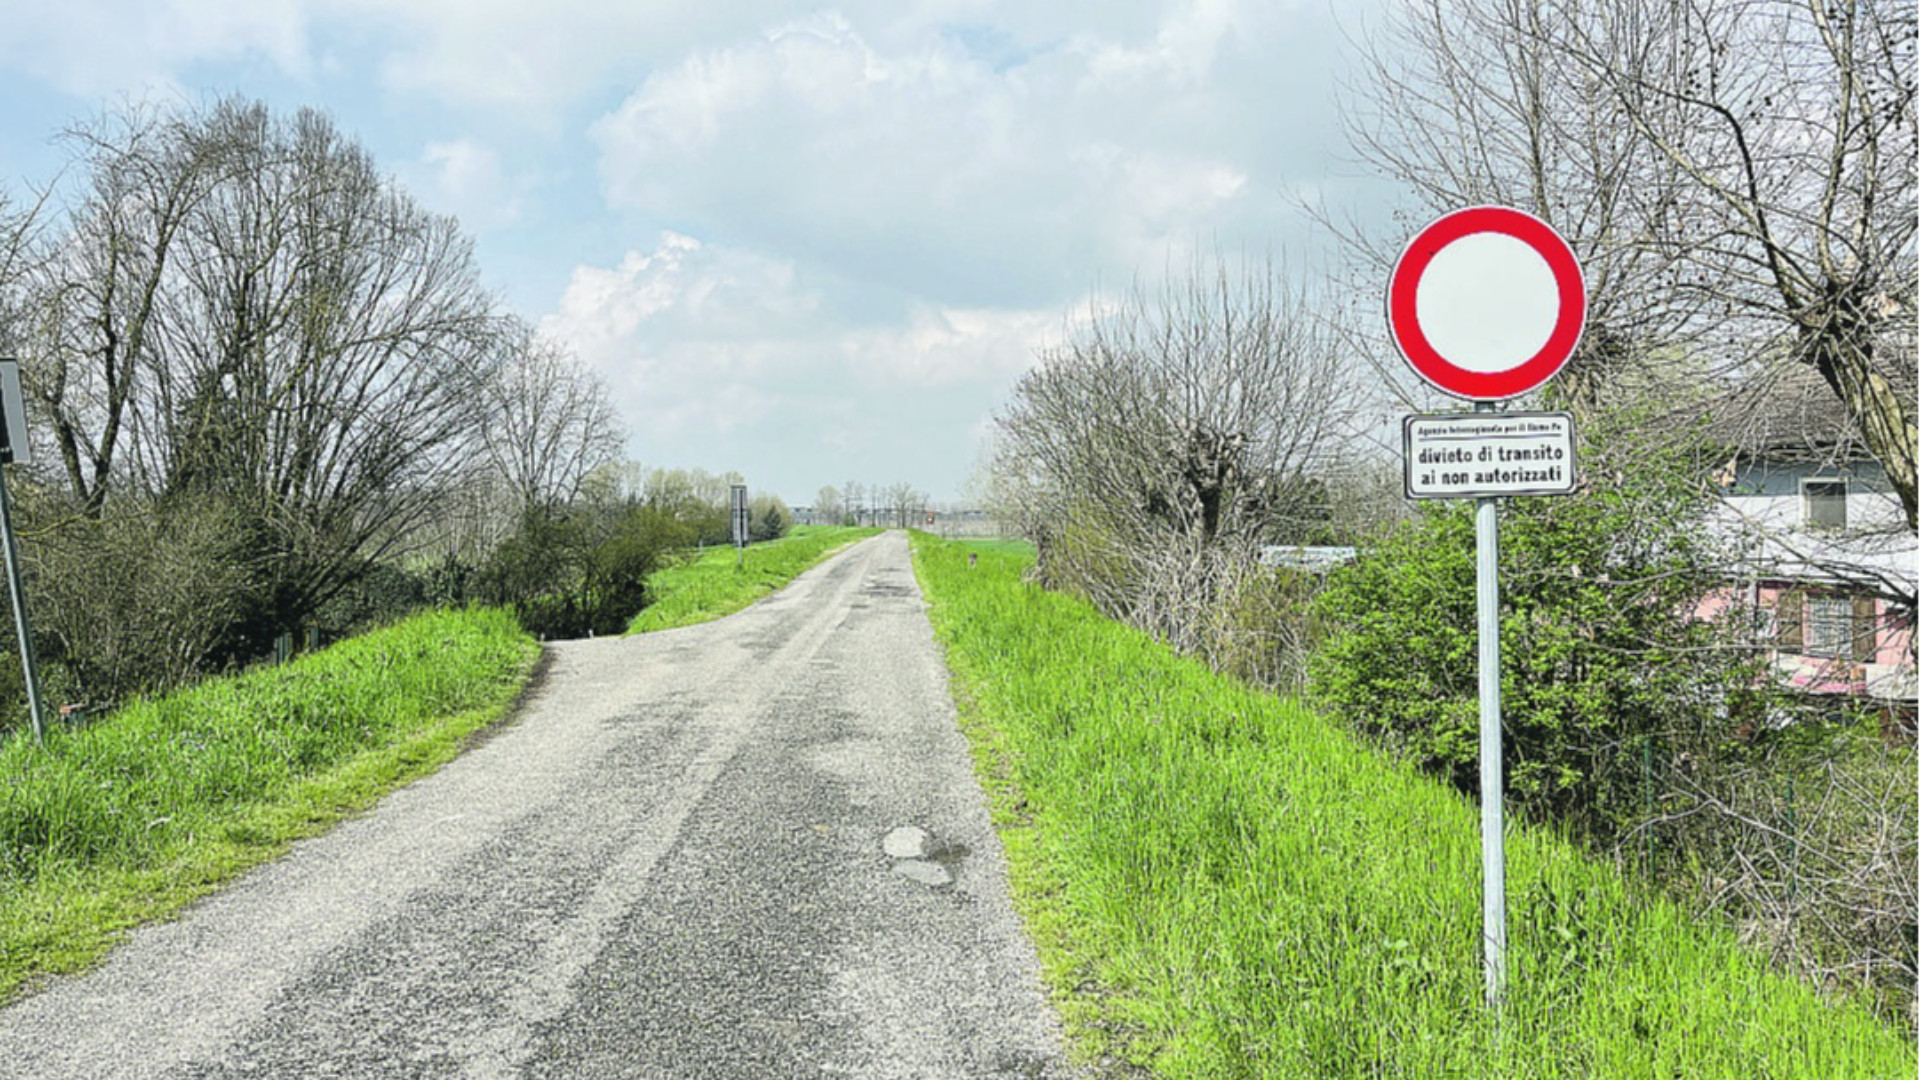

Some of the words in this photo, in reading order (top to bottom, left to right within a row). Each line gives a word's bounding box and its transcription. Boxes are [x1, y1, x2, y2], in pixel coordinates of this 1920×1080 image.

[1419, 447, 1473, 464] divieto
[1478, 446, 1492, 462] di
[1499, 444, 1563, 462] transito
[1421, 469, 1435, 485] ai
[1442, 471, 1469, 485] non
[1475, 466, 1561, 484] autorizzati
